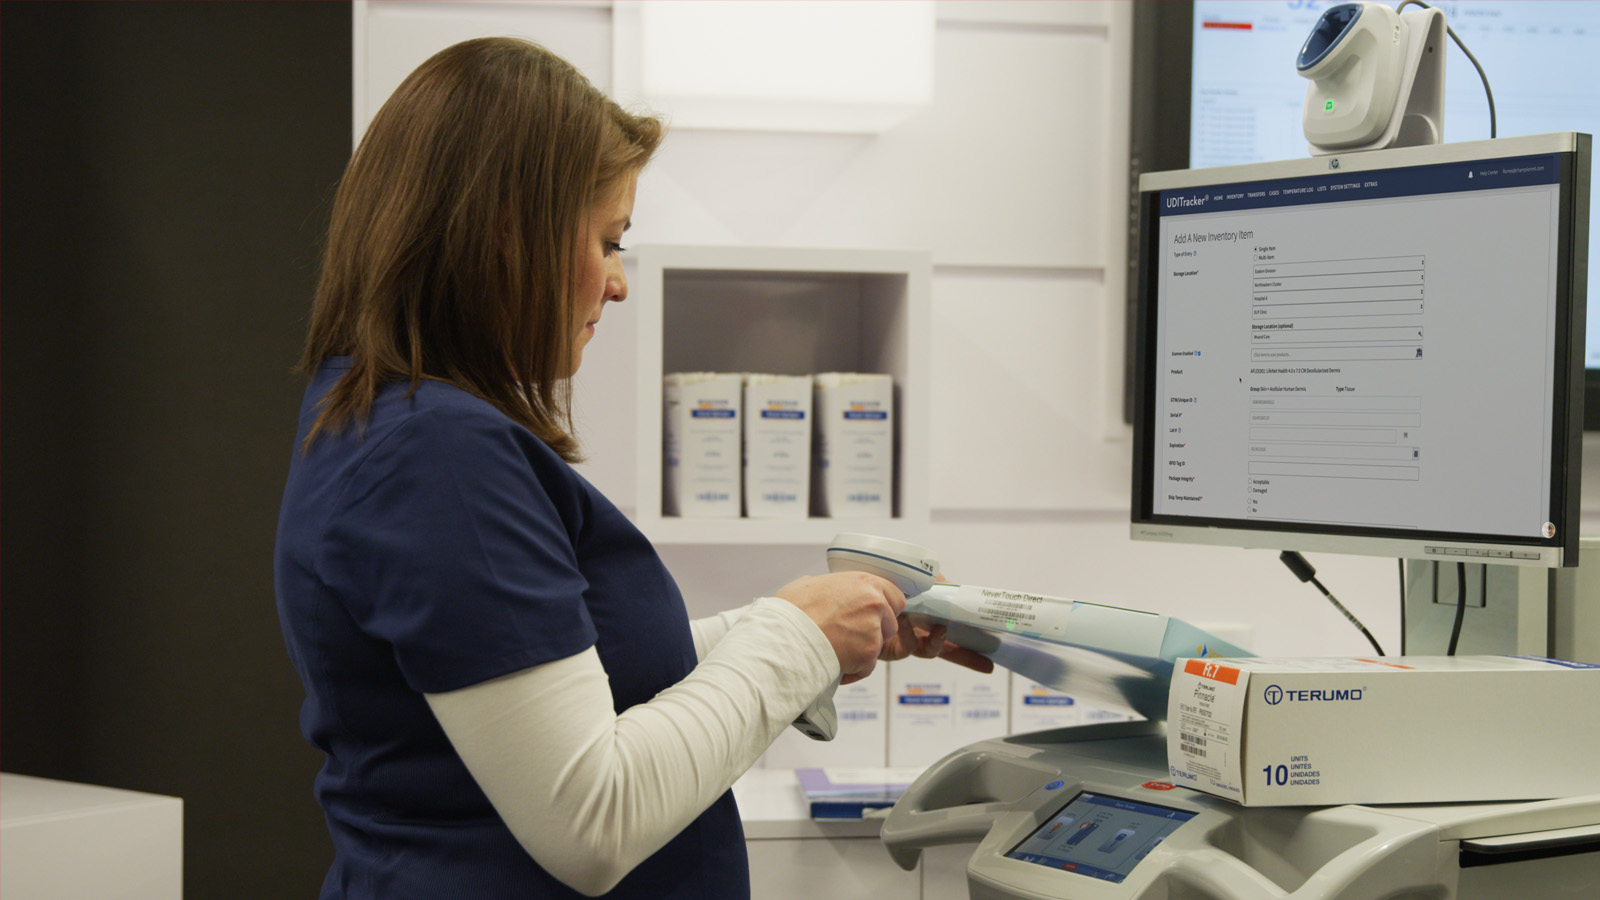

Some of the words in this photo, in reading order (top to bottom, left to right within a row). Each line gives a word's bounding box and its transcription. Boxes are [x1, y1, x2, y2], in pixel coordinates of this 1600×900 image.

[1174, 234, 1186, 244] Add
[1187, 234, 1192, 243] A
[1192, 232, 1207, 242] New
[1208, 231, 1238, 243] Inventory
[1239, 230, 1254, 240] Item
[982, 589, 1022, 601] NeverTouch
[1023, 594, 1043, 604] Direct
[1194, 689, 1216, 703] Pinnacle
[1286, 689, 1362, 702] TERUMO
[1262, 764, 1289, 786] 10
